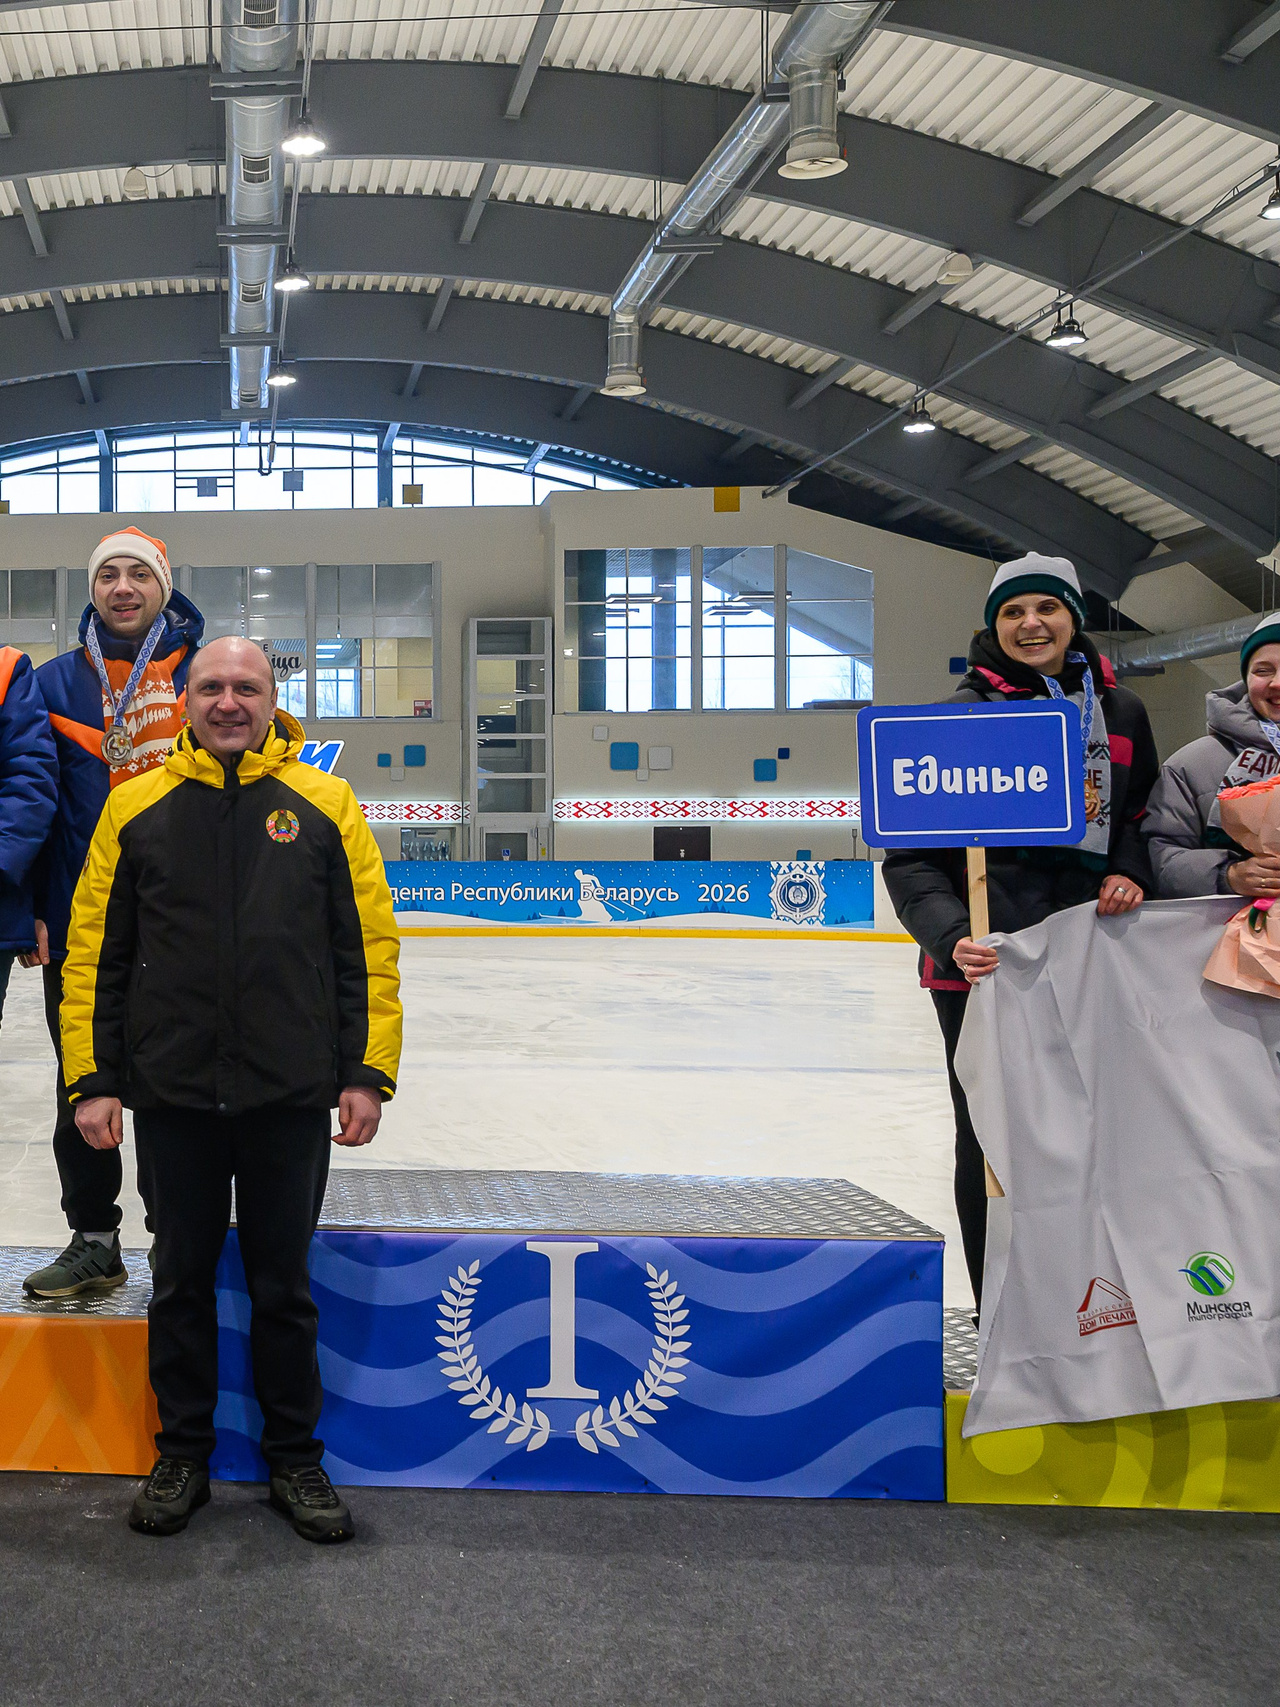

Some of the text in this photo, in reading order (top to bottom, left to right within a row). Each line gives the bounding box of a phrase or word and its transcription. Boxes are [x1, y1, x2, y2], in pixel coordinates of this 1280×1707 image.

[892, 755, 1049, 797] Единые
[450, 882, 574, 906] Республики
[579, 882, 680, 906] Беларусь
[697, 883, 751, 903] 2026
[1186, 1301, 1252, 1316] Минская
[1188, 1311, 1254, 1322] типография
[1079, 1310, 1137, 1333] ДОМ ПЕЧАТИ
